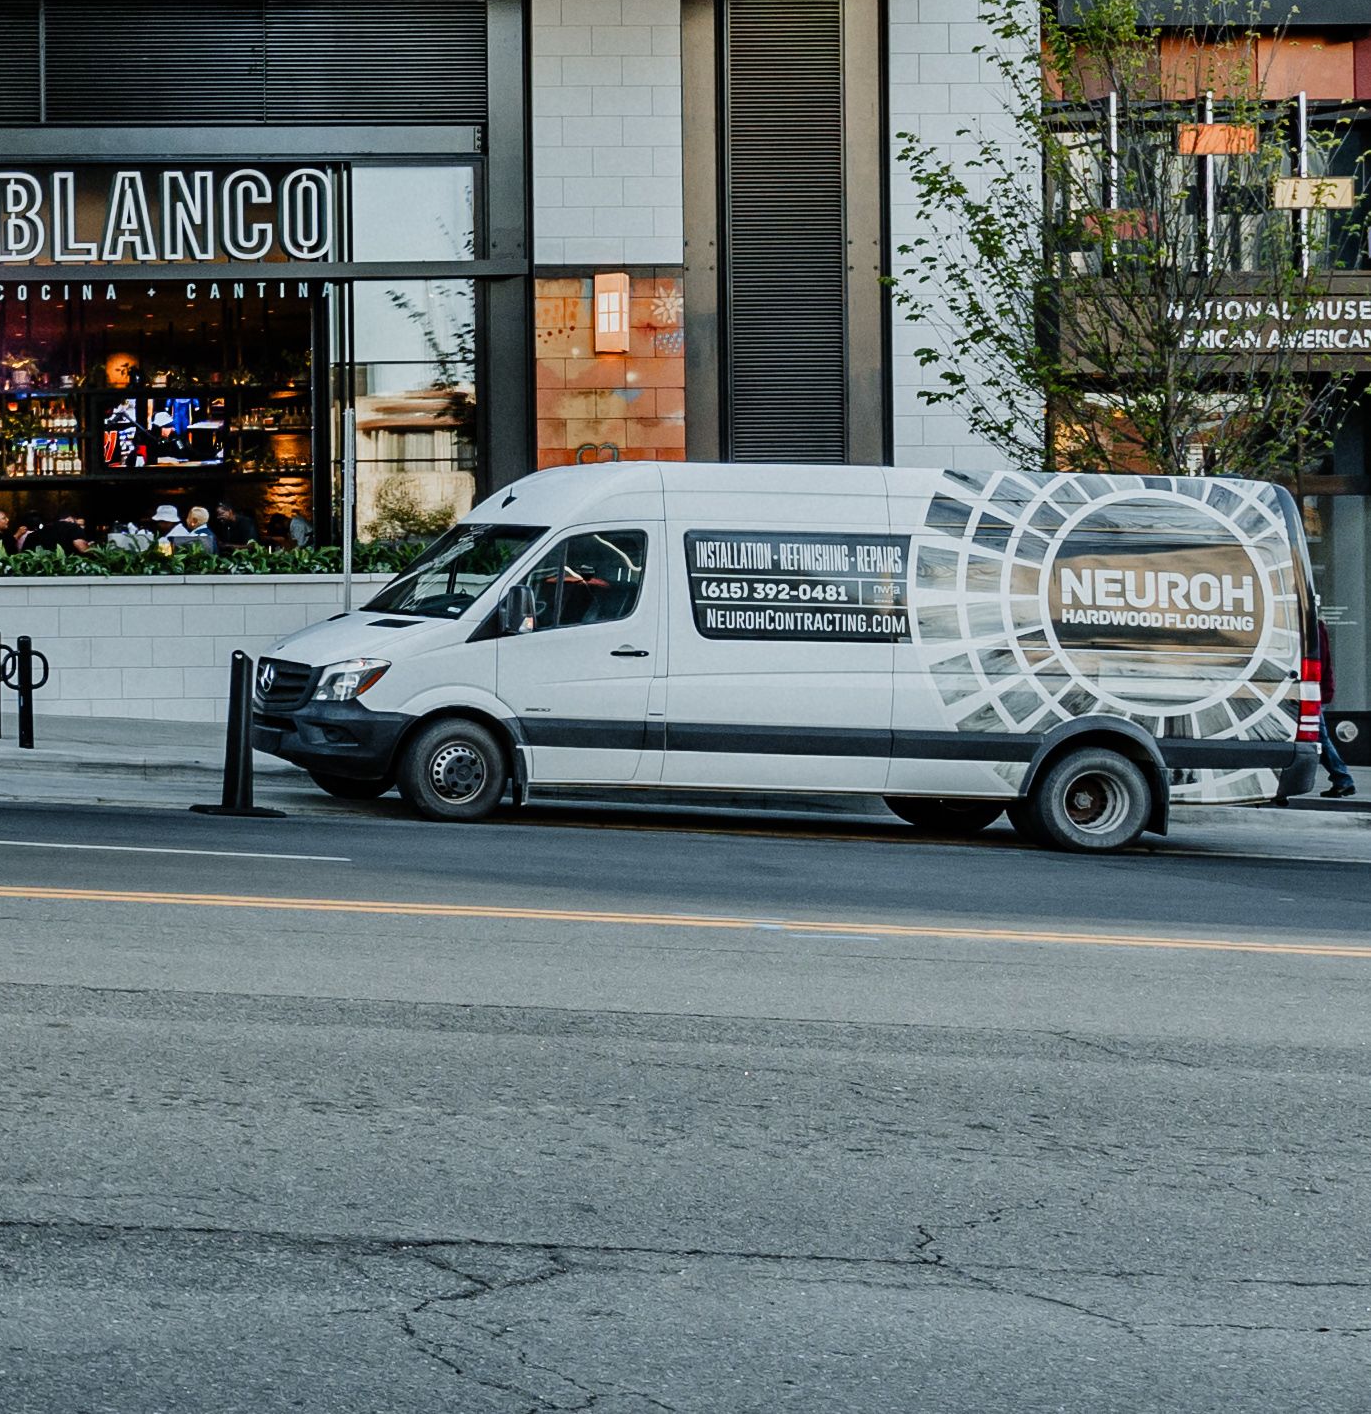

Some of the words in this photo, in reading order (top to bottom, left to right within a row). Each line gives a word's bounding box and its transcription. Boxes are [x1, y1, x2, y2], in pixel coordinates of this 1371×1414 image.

[186, 282, 332, 300] CANTINA
[695, 541, 772, 570] INSTALLATION
[779, 543, 849, 572] REFINISHING
[856, 545, 903, 574] REPAIRS
[701, 580, 749, 599] (615)
[752, 582, 849, 602] 392-0481
[1060, 567, 1255, 613] NEUROH
[1061, 609, 1163, 627] HARDWOOD
[1165, 613, 1255, 632] FLOORING
